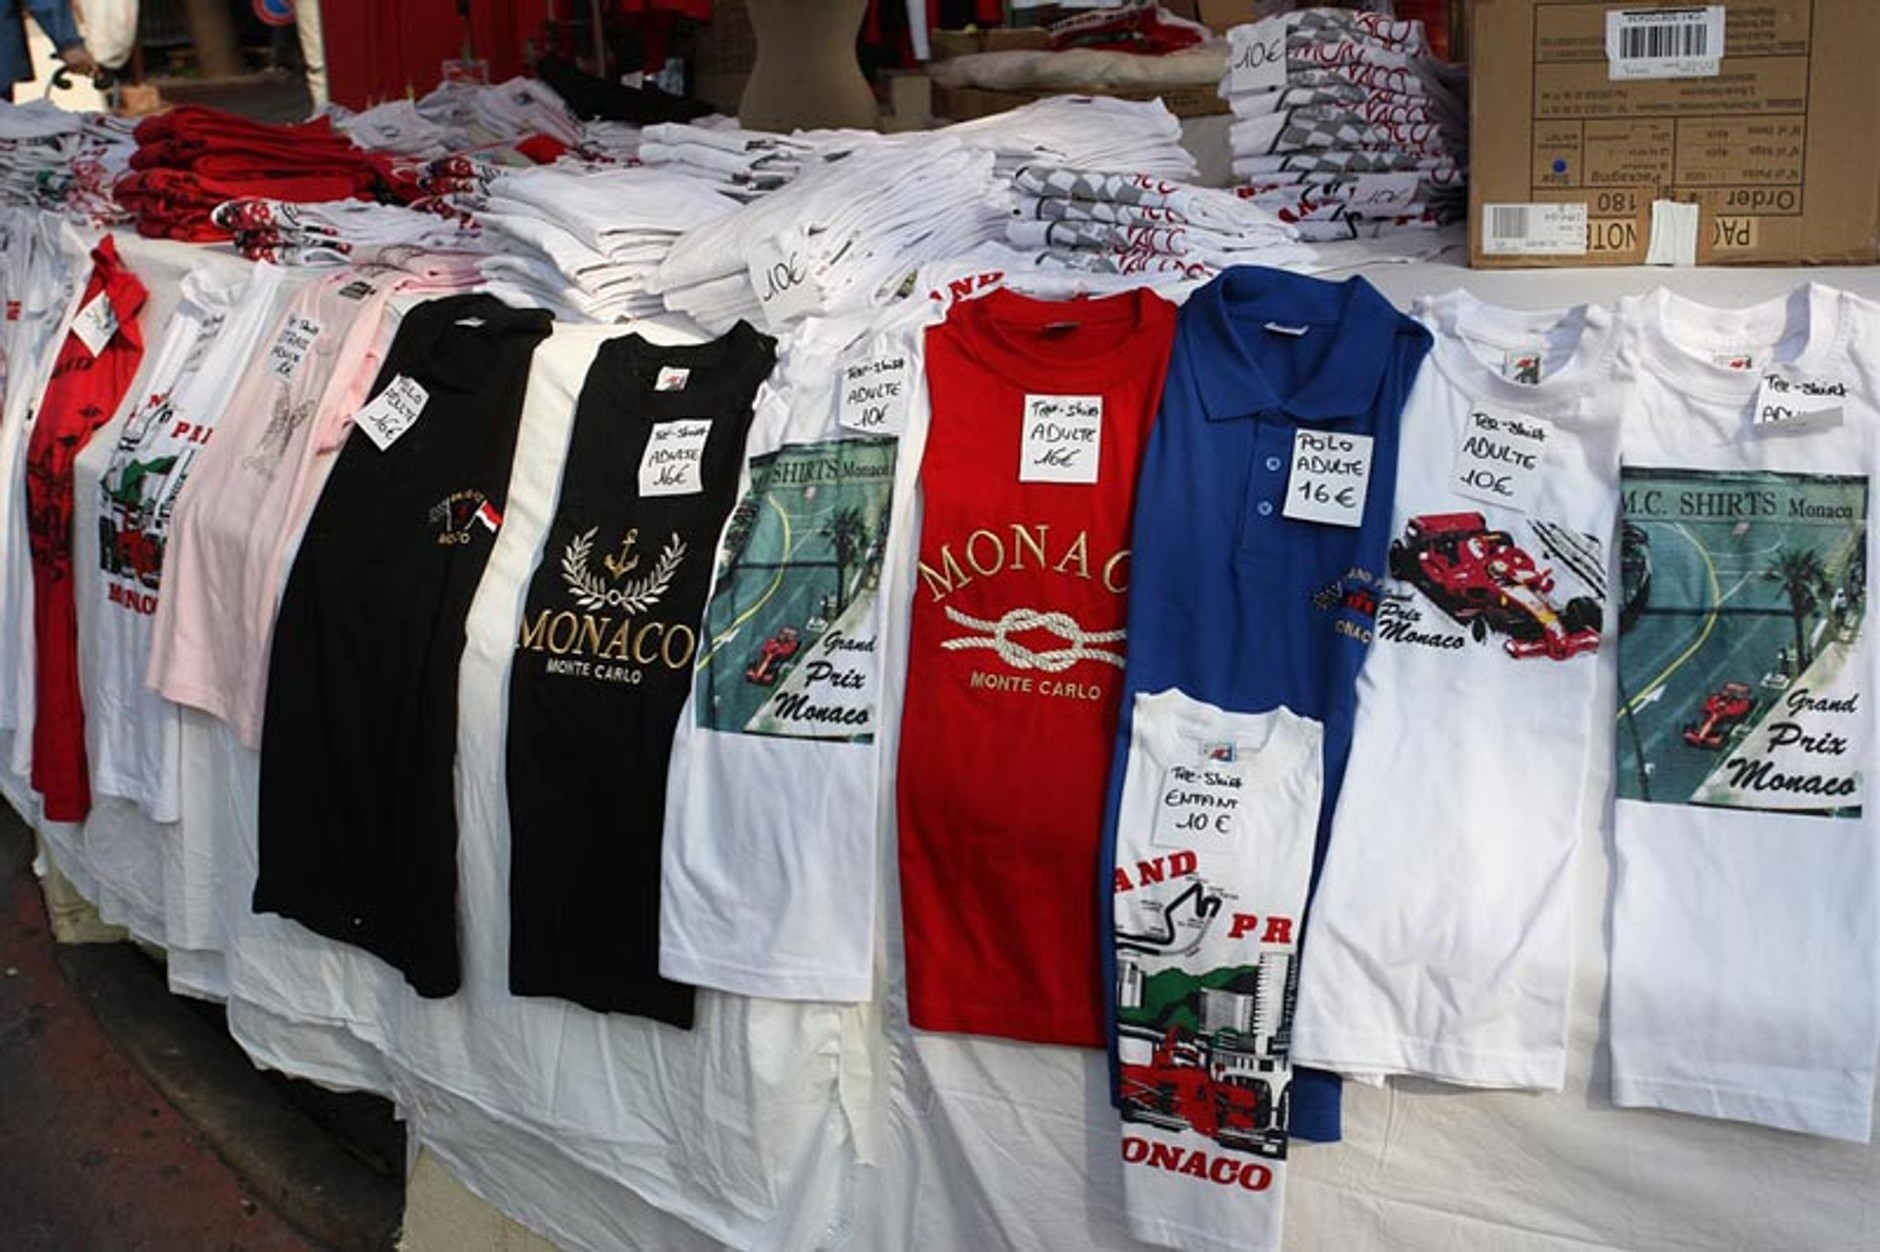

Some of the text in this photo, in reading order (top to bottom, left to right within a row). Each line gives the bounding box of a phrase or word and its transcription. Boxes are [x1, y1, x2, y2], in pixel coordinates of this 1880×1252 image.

[1234, 38, 1283, 70] 10€
[1598, 193, 1637, 212] 180
[1726, 190, 1795, 208] Order
[764, 251, 807, 302] 10€
[847, 383, 901, 404] ADULTE
[854, 403, 889, 427] 10€
[1030, 422, 1097, 443] ADULTE
[1297, 432, 1353, 452] POLO
[1033, 446, 1082, 468] 16€
[1297, 455, 1363, 476] ADULTE
[1462, 436, 1537, 470] ADULTE
[652, 463, 690, 487] 16€
[771, 459, 838, 483] SHIRTS
[1459, 469, 1514, 496] 10€
[1680, 491, 1778, 516] SHIRTS
[1788, 498, 1853, 518] Monaco
[1379, 602, 1422, 621] Prix
[516, 608, 695, 669] MONACO
[823, 630, 878, 655] Grand
[1379, 619, 1465, 649] Monaco
[546, 658, 643, 685] MONTE CARLO
[805, 661, 866, 691] Prix
[970, 671, 1101, 701] MONTE CARLO
[774, 691, 870, 726] Monaco
[1786, 688, 1860, 717] Grand
[1766, 722, 1848, 756] Prix
[1726, 757, 1857, 797] Monaco
[1165, 788, 1239, 810] ENFANT
[1113, 850, 1198, 894] AND
[1227, 912, 1293, 944] PR
[1121, 1136, 1273, 1192] ONACO
